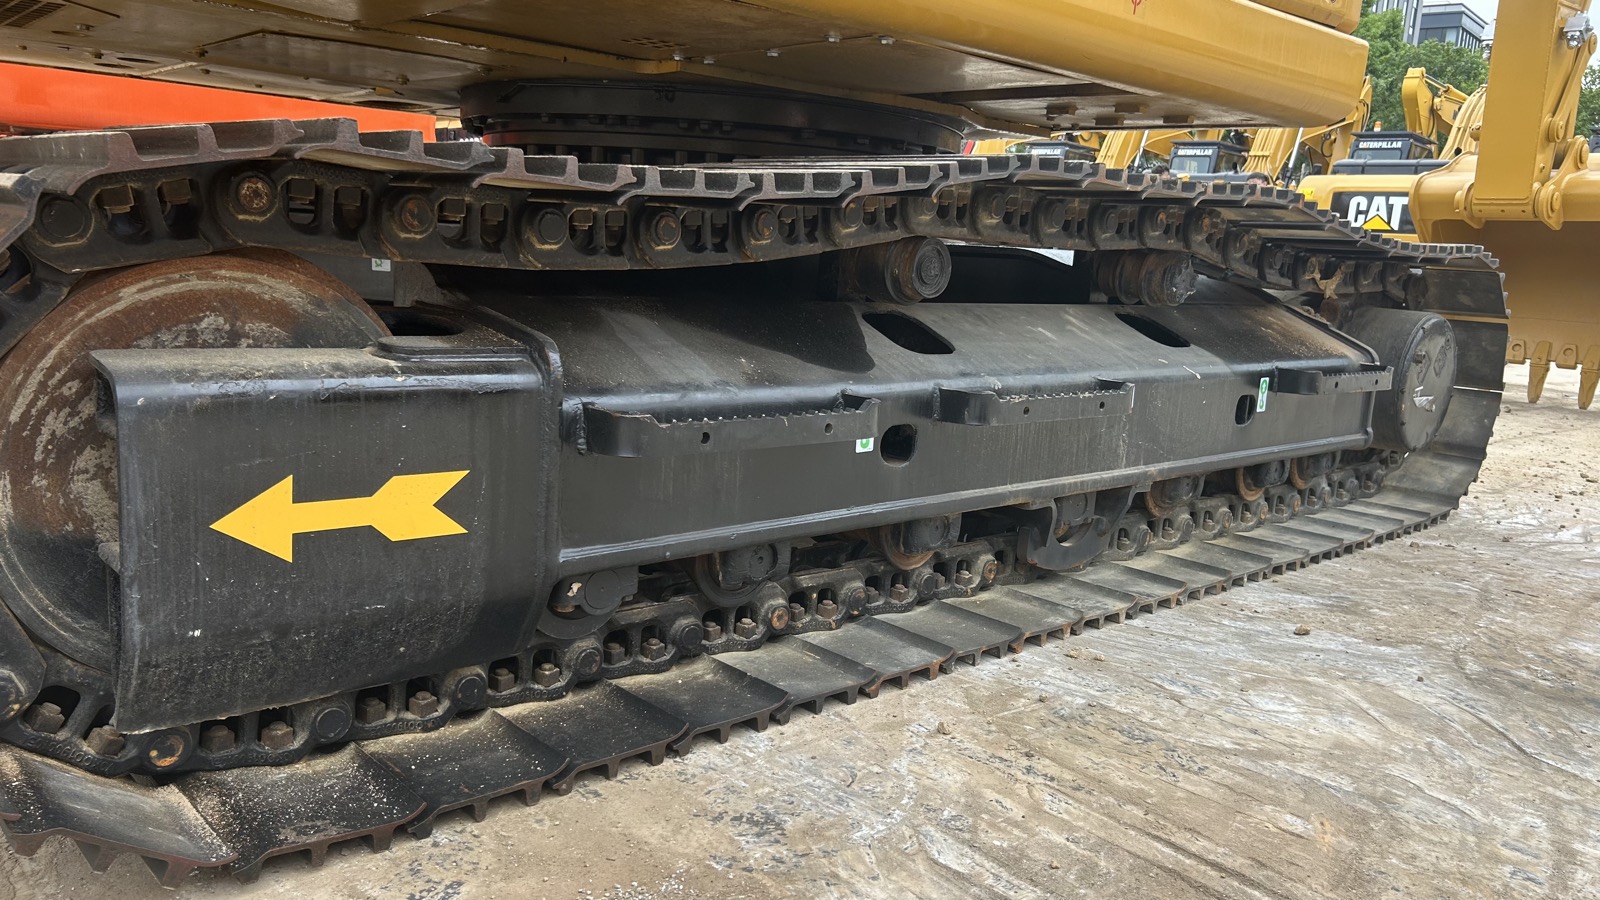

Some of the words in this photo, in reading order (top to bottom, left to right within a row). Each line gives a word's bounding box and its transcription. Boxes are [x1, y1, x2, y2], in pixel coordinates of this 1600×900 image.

[1358, 141, 1402, 149] CATERPILLAR
[1177, 148, 1213, 156] CATERPILLAR
[1347, 195, 1409, 231] CAT
